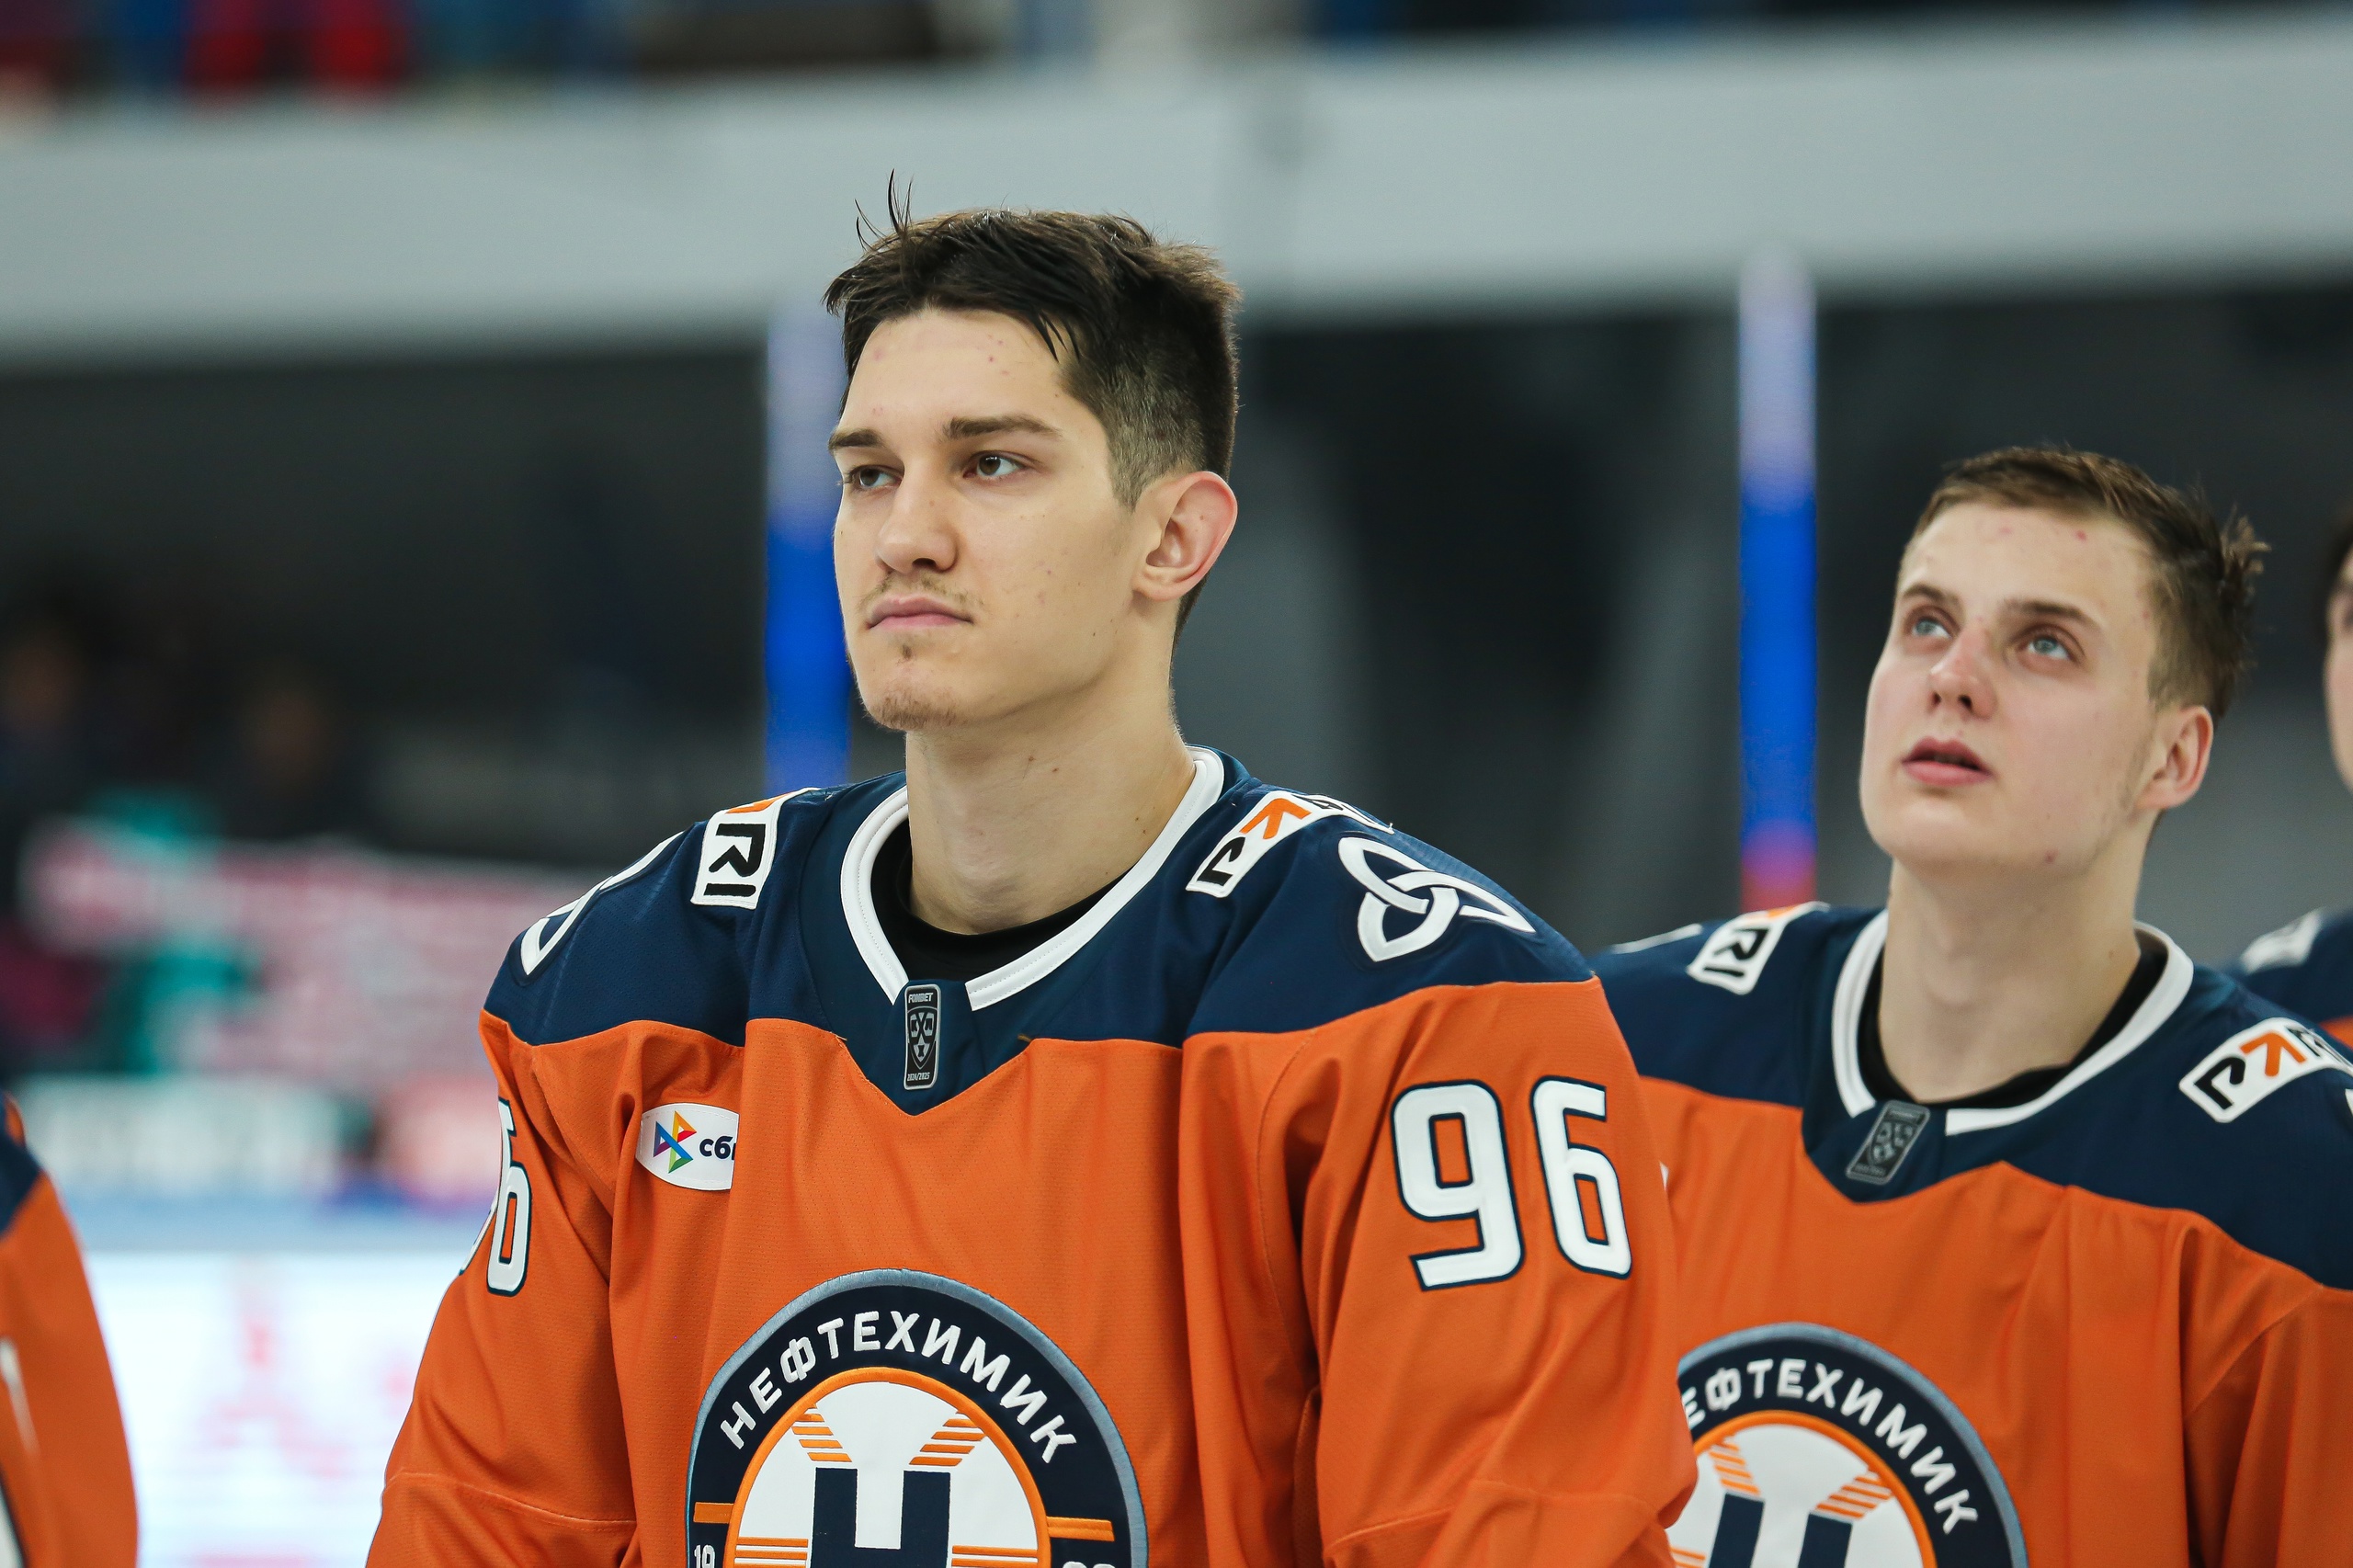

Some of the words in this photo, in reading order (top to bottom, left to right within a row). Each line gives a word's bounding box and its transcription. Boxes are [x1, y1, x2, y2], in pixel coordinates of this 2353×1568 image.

[703, 796, 777, 898] RI
[459, 1096, 532, 1298] 6
[1391, 1074, 1632, 1291] 96
[720, 1311, 1076, 1464] НЕФТЕХИМИК
